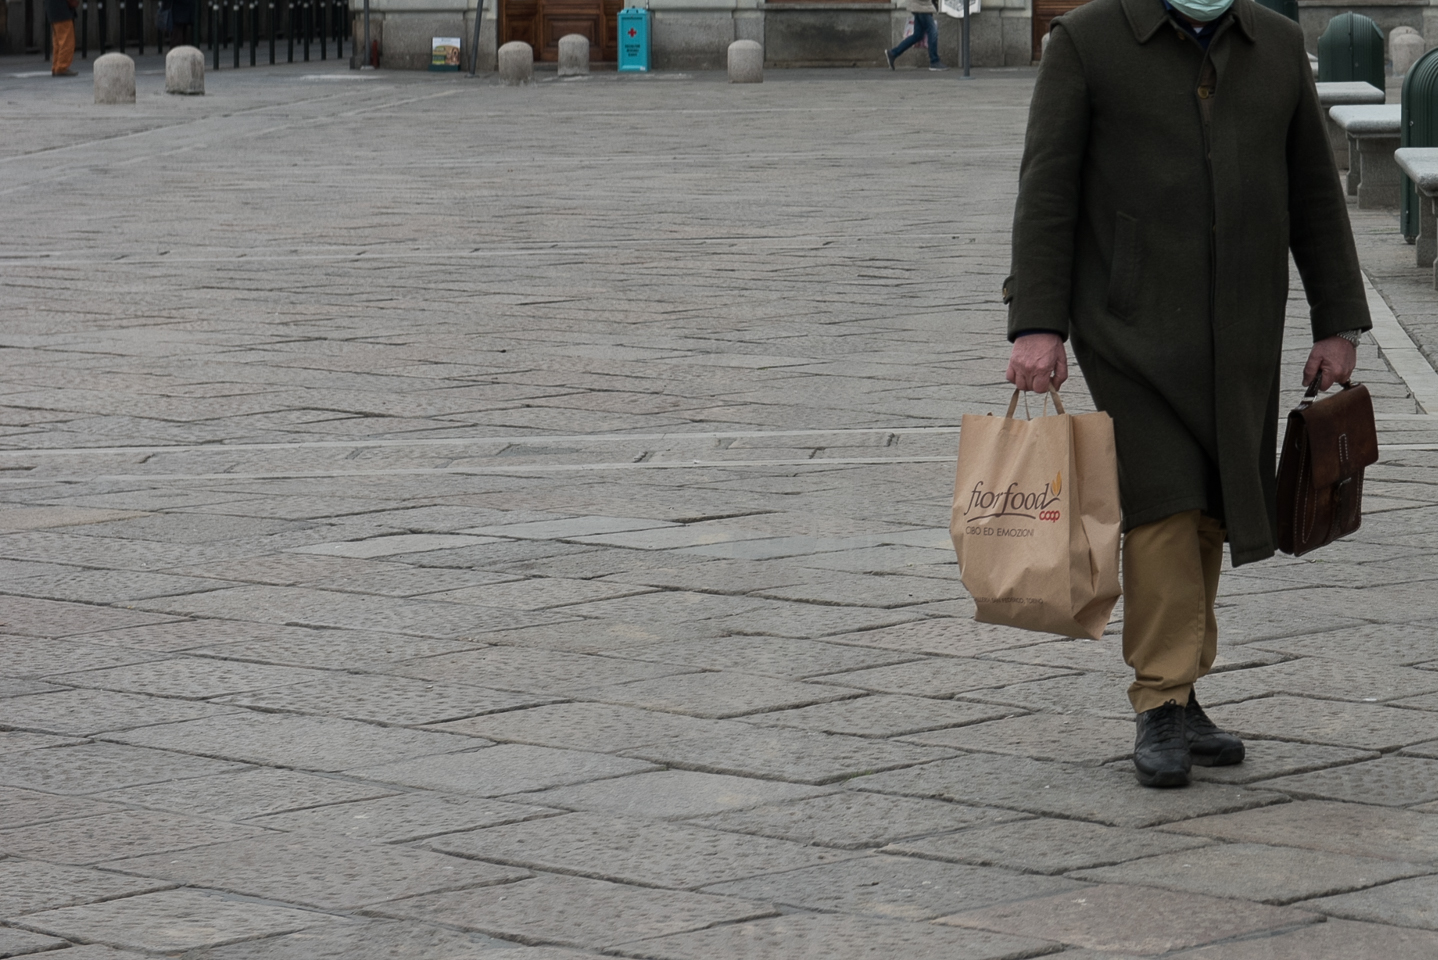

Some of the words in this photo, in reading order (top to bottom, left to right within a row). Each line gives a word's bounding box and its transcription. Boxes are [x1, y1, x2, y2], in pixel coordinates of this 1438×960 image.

[964, 480, 1051, 519] fiorfood
[1039, 510, 1061, 523] coop
[965, 525, 981, 535] CIBO
[983, 526, 995, 536] ED
[996, 527, 1034, 537] EMOZIONI
